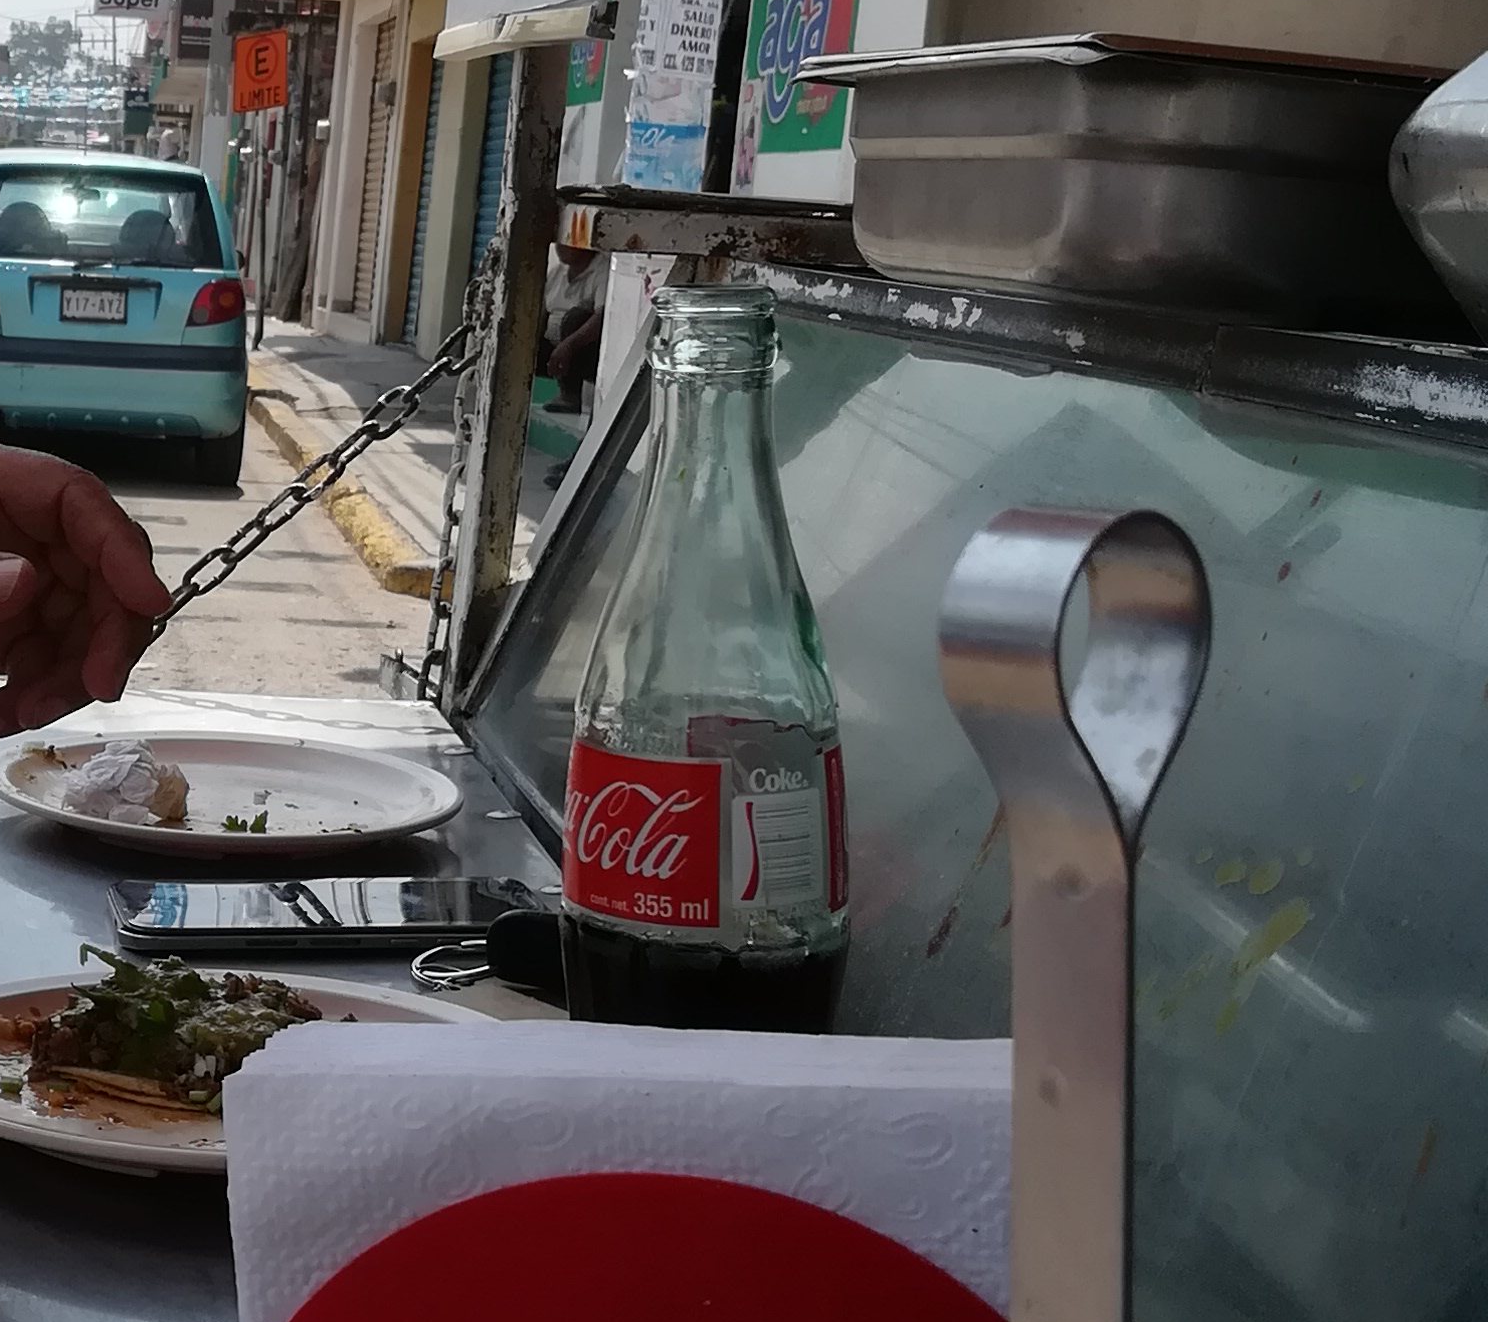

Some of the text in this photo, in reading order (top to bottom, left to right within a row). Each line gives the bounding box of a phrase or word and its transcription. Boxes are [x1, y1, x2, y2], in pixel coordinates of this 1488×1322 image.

[670, 23, 711, 39] DINERO
[254, 45, 270, 76] E
[239, 86, 281, 109] LIMITE
[632, 891, 673, 918] 355
[680, 898, 709, 921] ml
